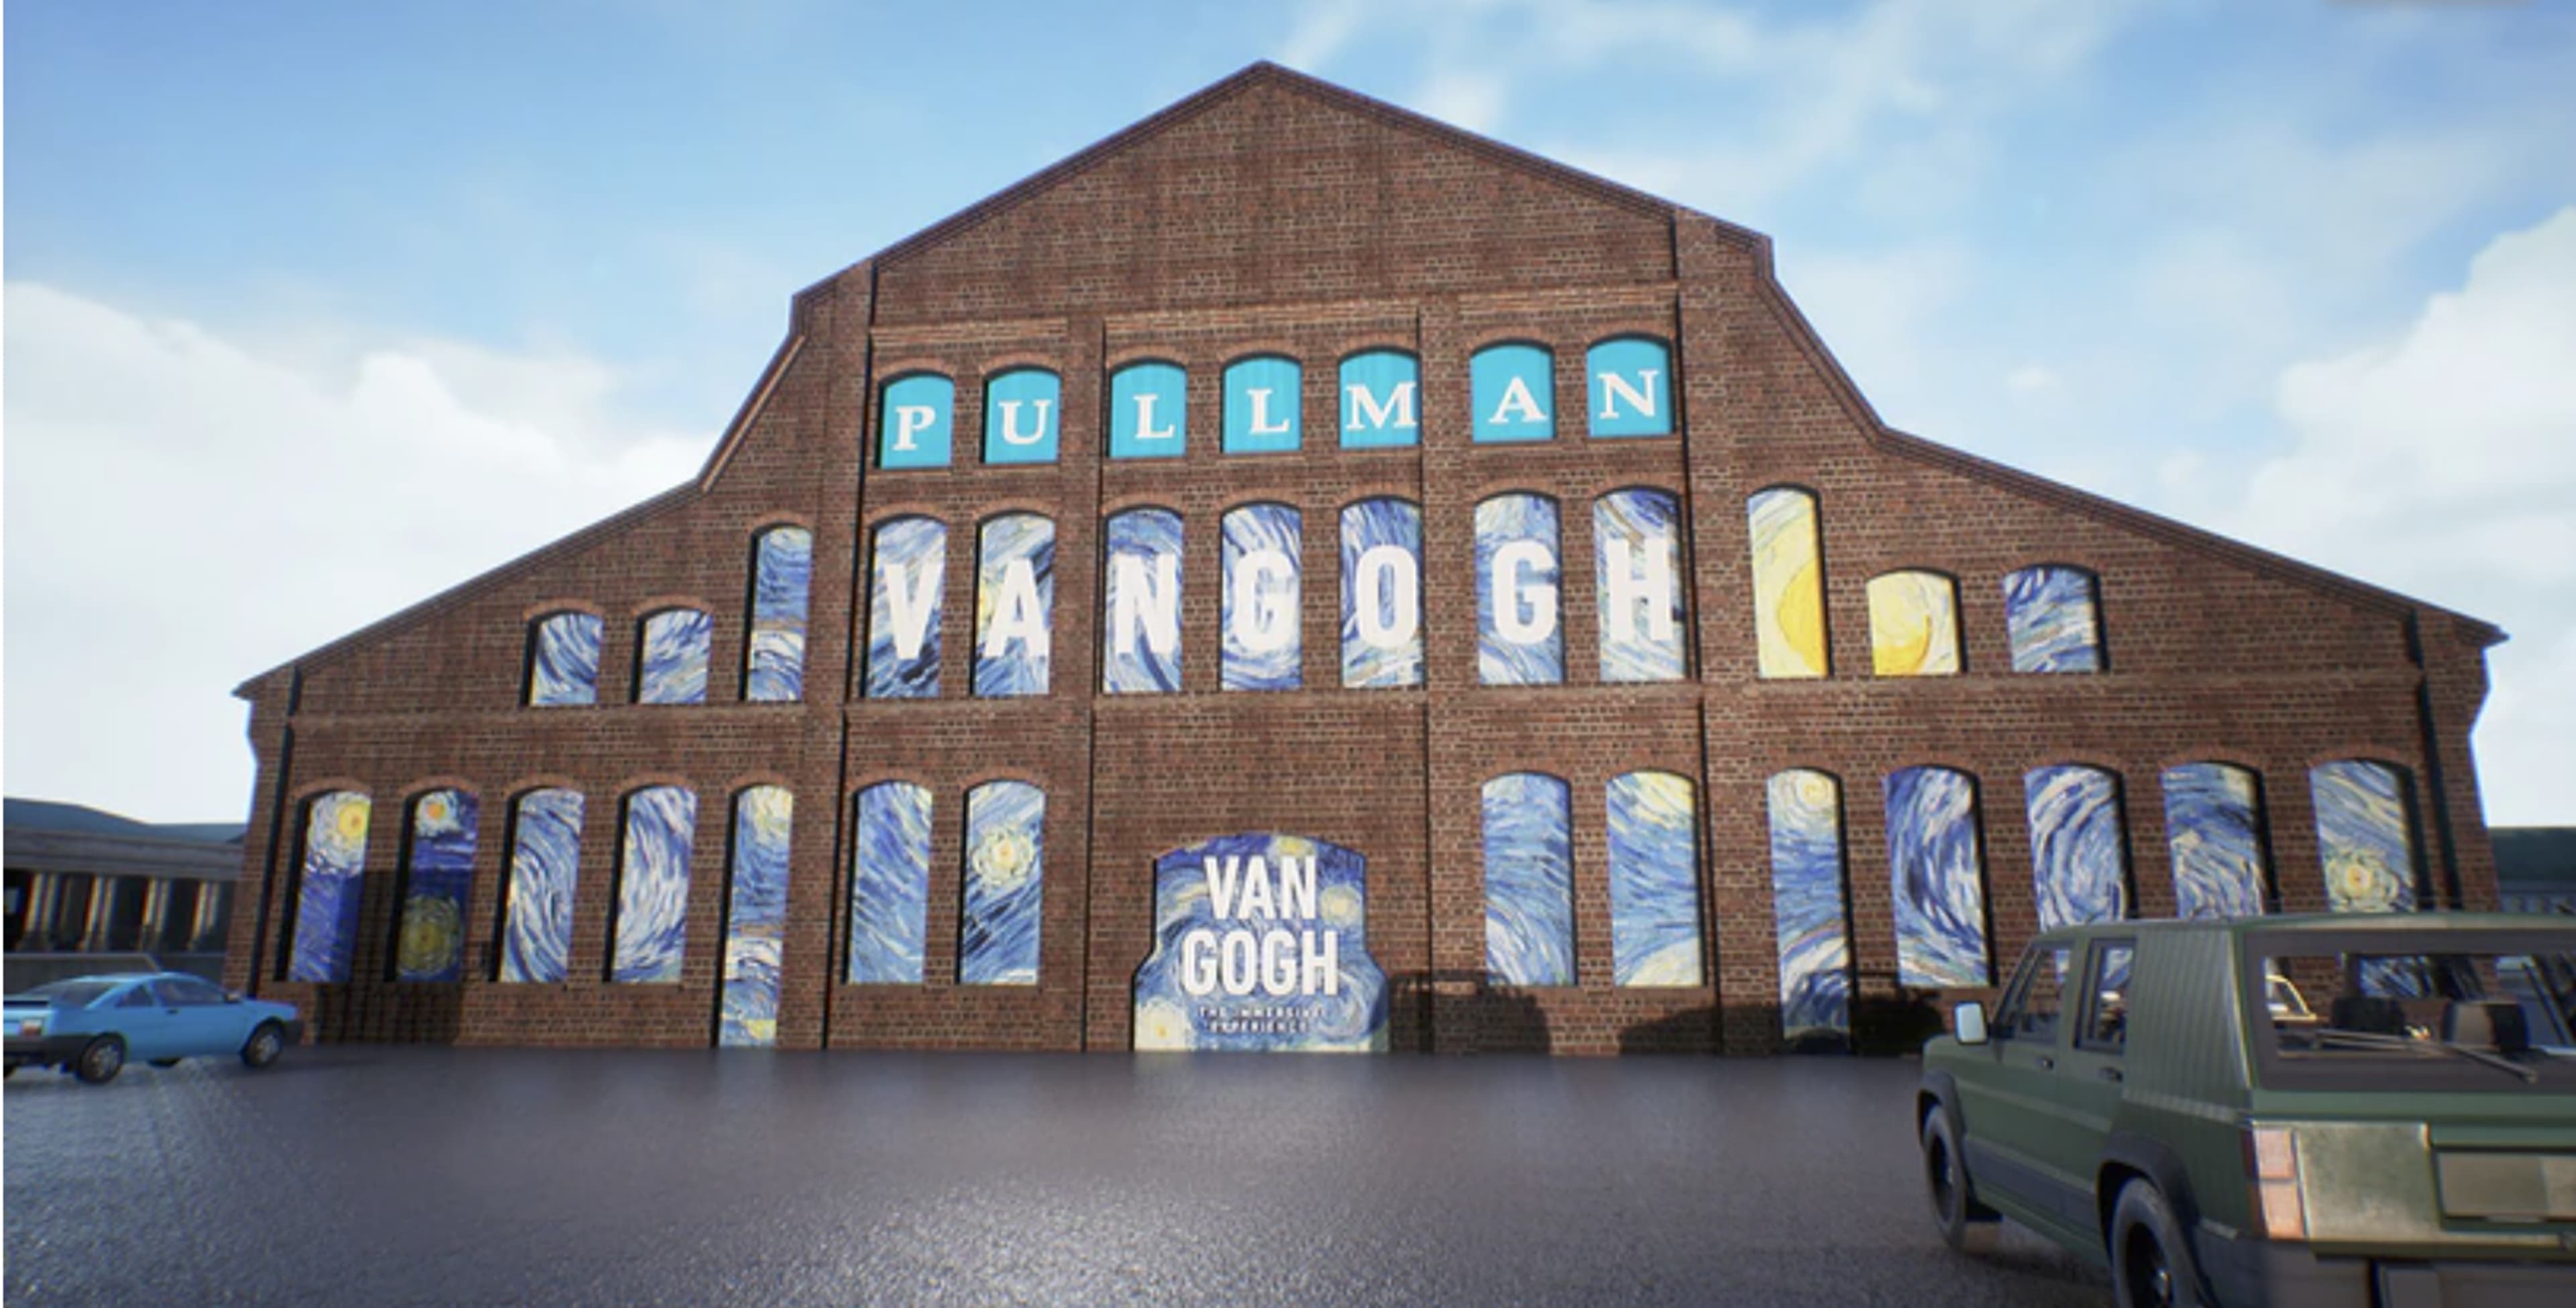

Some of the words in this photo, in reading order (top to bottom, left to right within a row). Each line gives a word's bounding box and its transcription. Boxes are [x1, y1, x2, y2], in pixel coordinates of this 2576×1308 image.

[893, 370, 1659, 451] PULLMAN
[1203, 855, 1316, 920] VAN
[1183, 930, 1338, 995] GOGH
